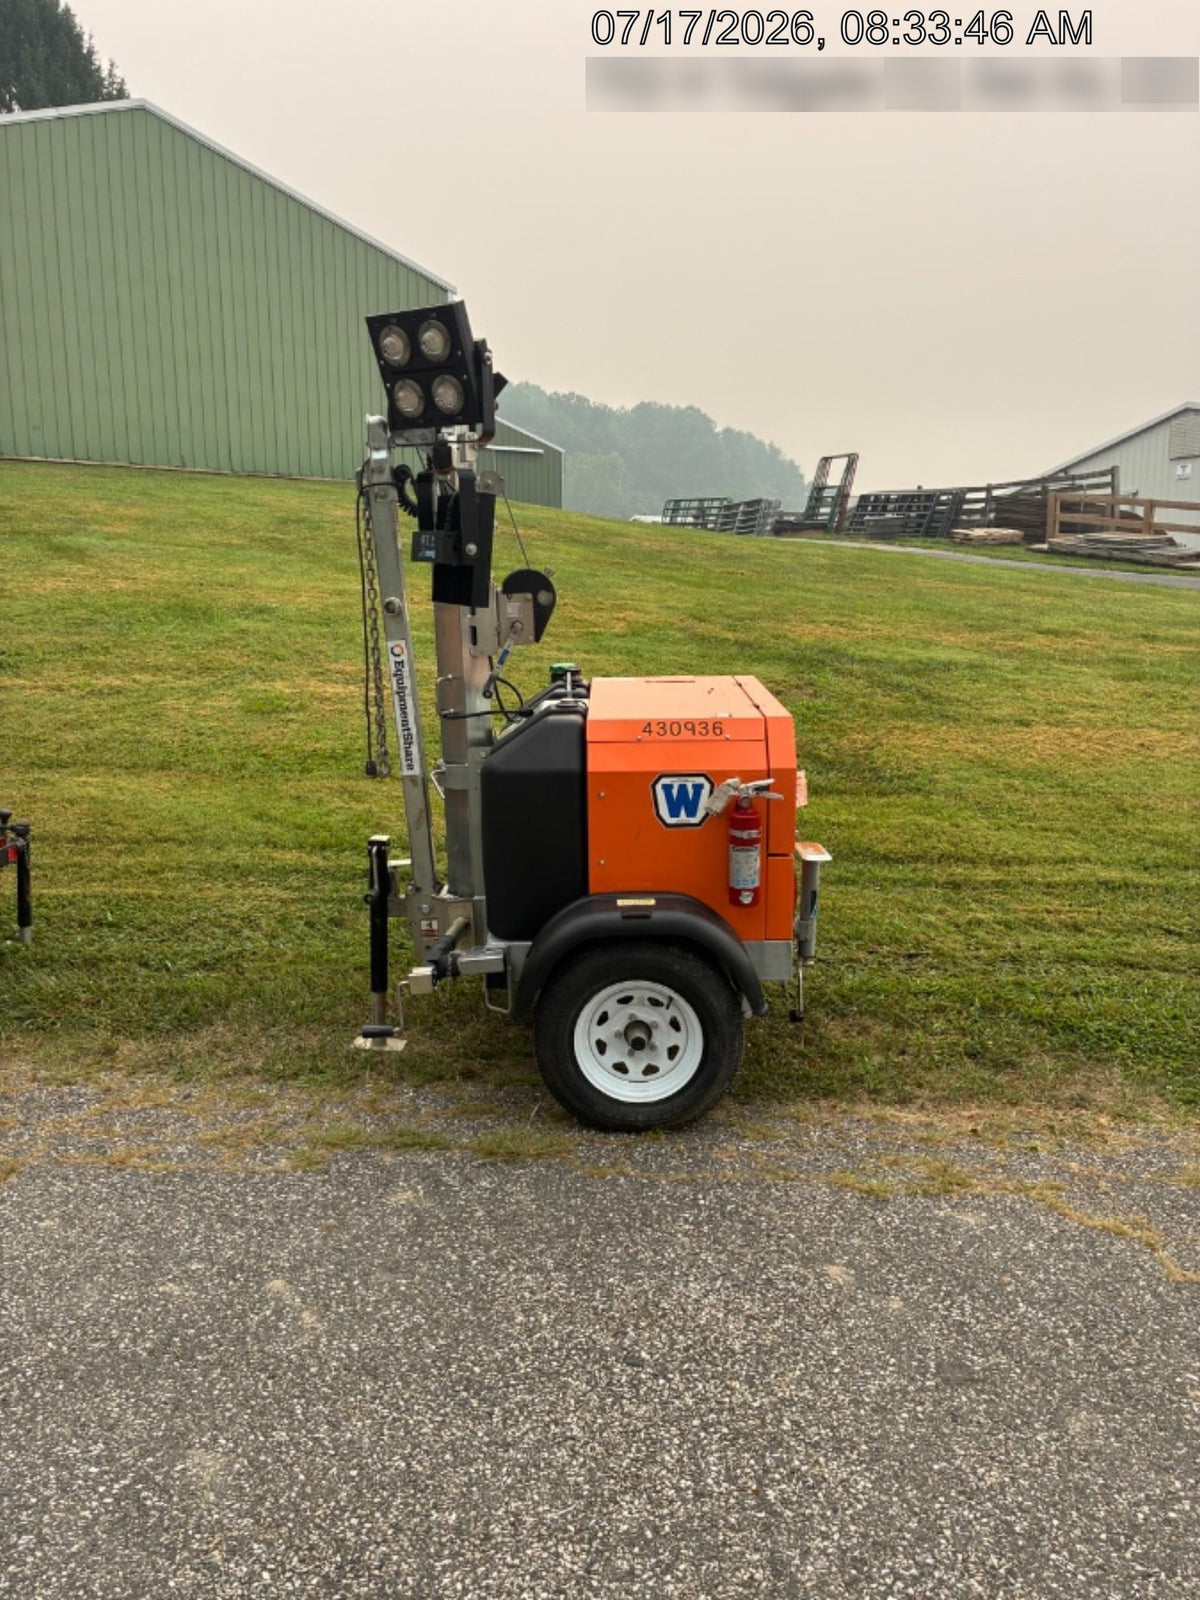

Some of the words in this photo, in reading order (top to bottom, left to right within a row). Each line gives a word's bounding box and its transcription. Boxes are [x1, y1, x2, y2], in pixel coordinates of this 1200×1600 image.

[393, 659, 415, 771] EquipmentShare
[642, 721, 723, 737] 430936
[661, 783, 704, 819] W
